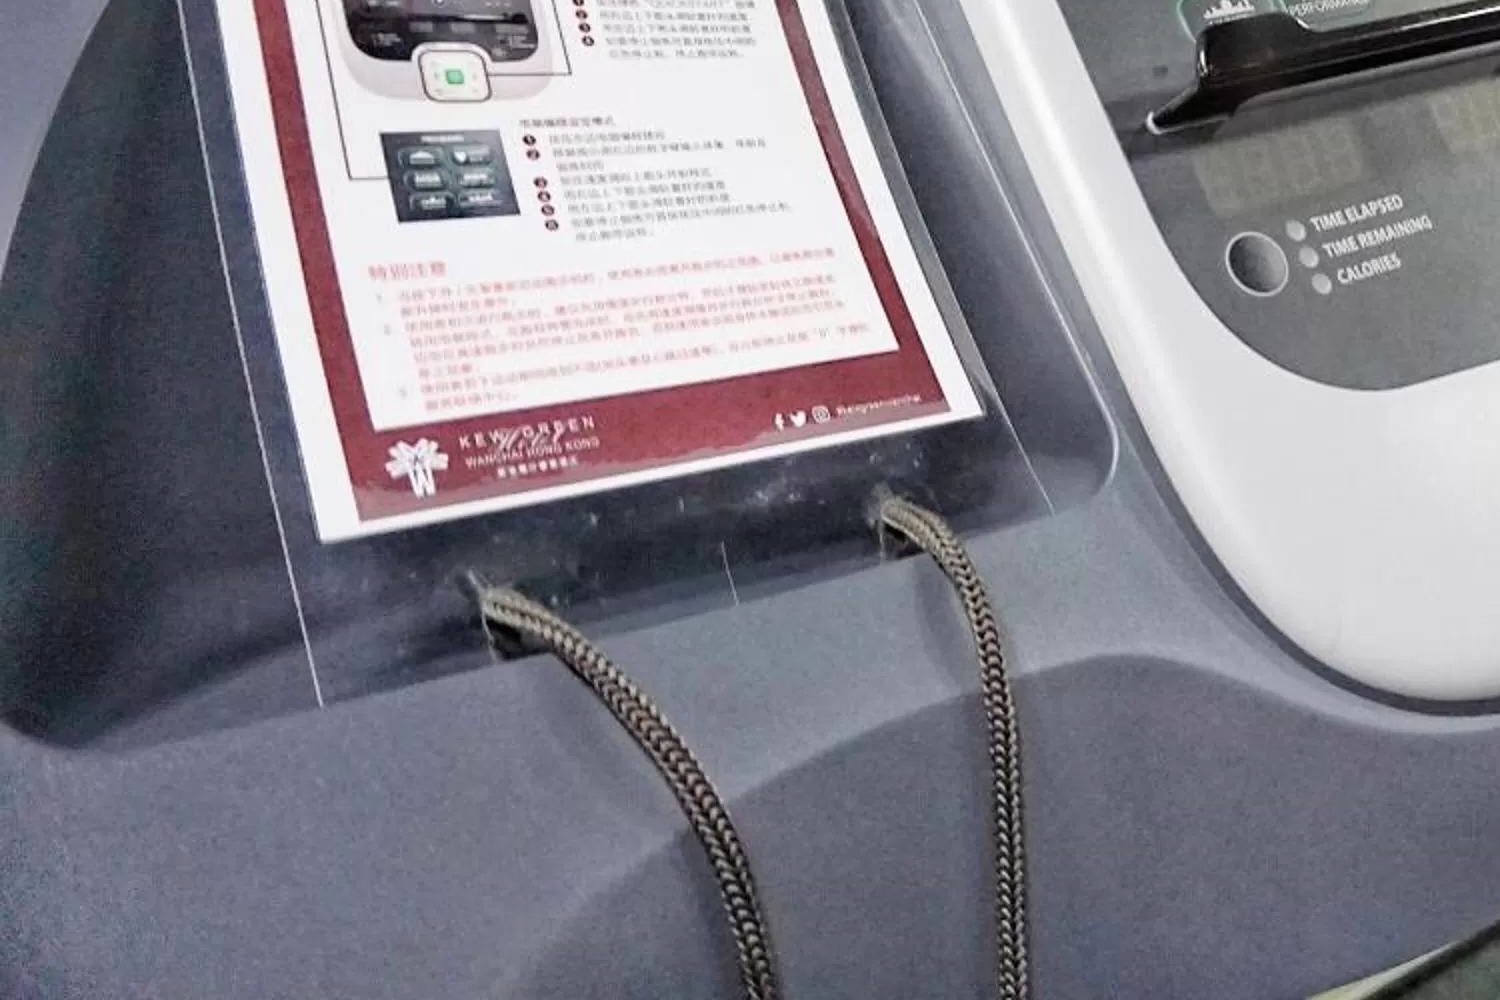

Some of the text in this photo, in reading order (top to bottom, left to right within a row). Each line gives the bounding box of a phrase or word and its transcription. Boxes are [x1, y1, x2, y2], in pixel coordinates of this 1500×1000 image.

[1310, 194, 1404, 232] TIME ELAPSED
[1322, 214, 1433, 258] TIME REMAINING
[1337, 252, 1402, 285] CALORIES
